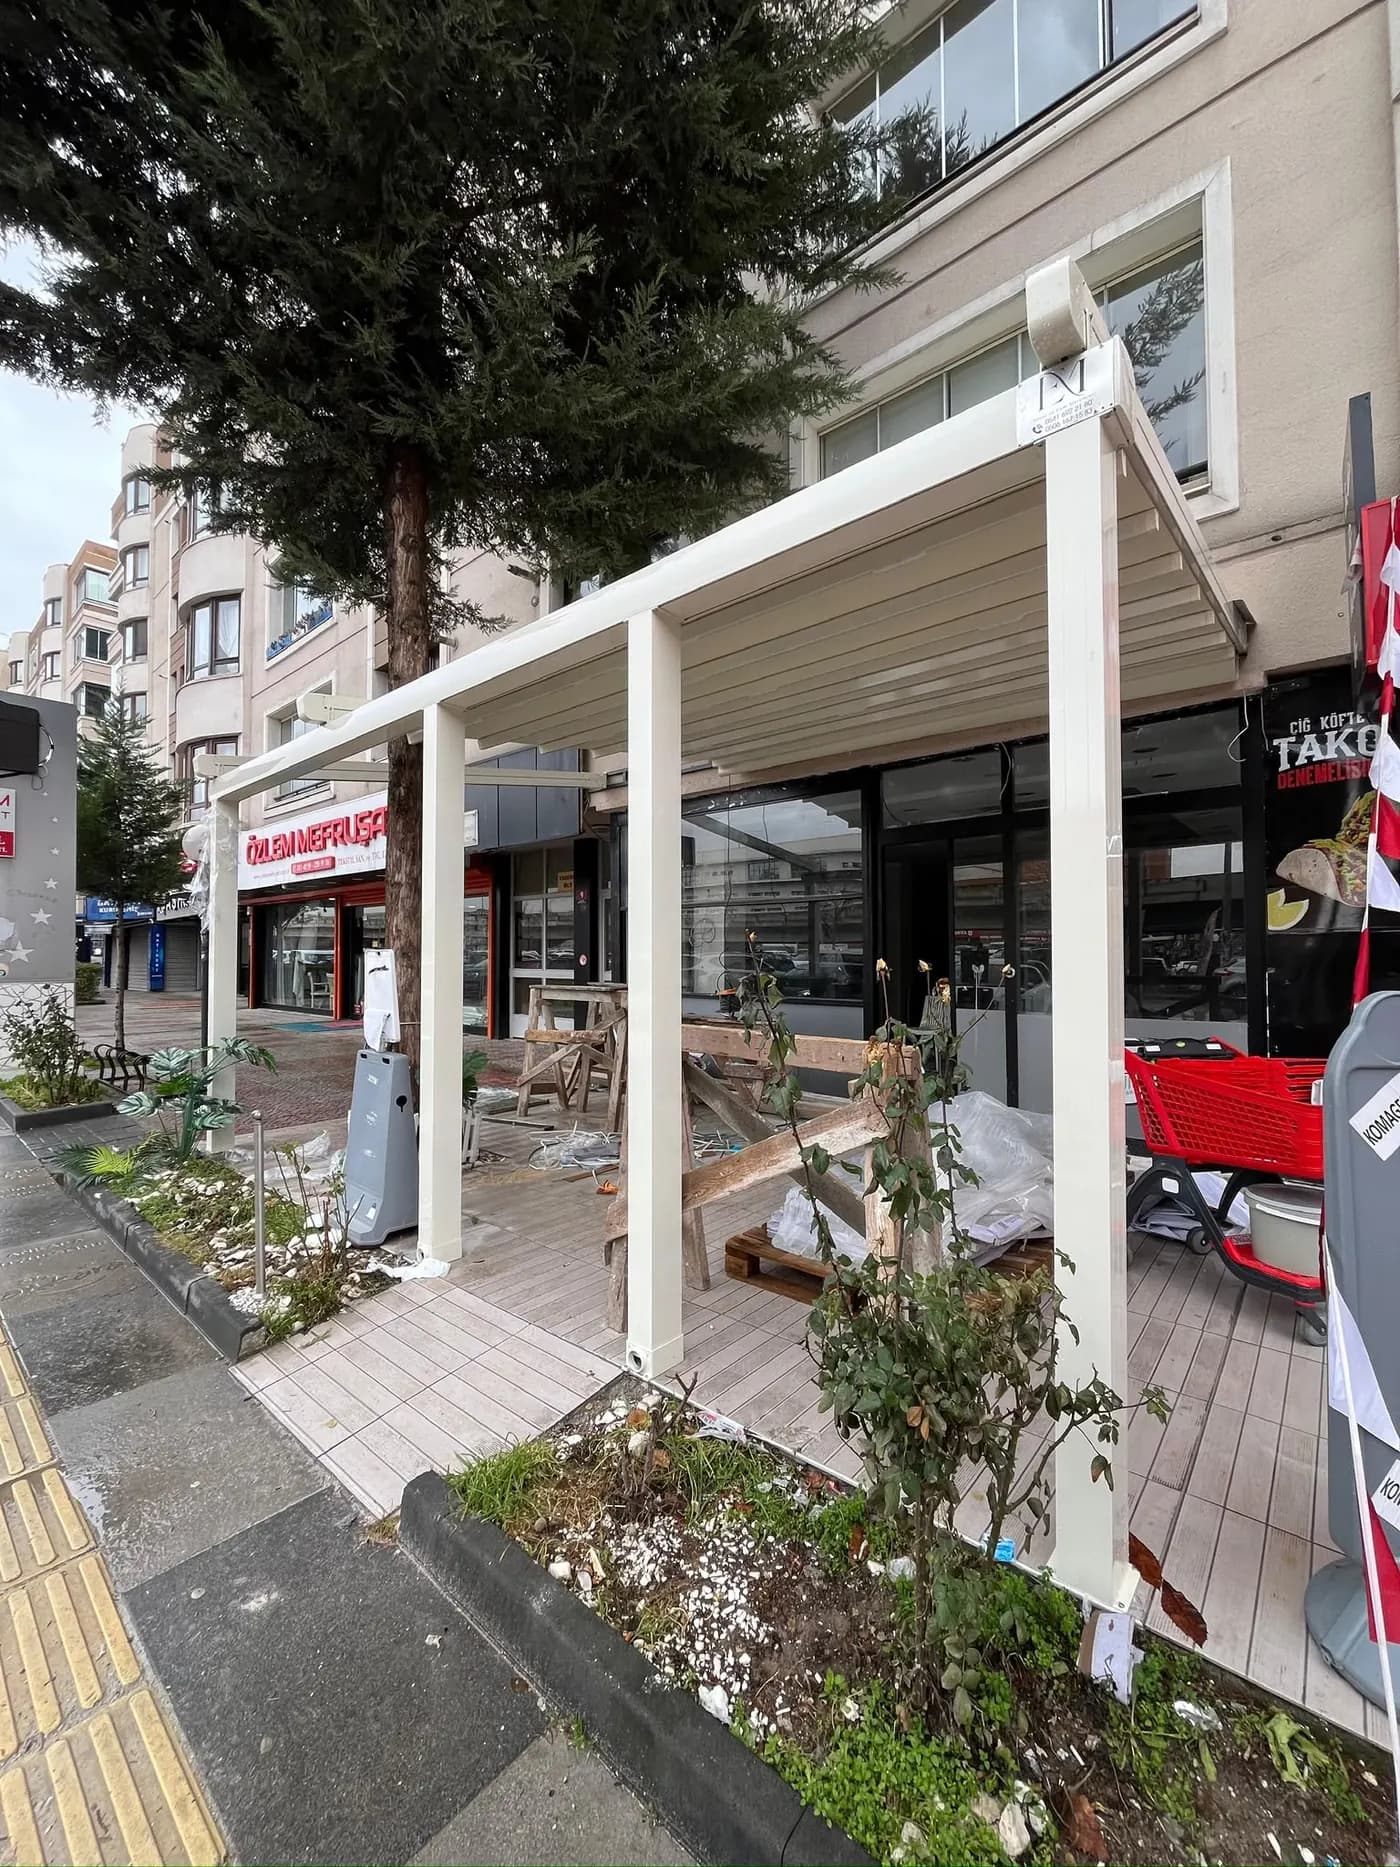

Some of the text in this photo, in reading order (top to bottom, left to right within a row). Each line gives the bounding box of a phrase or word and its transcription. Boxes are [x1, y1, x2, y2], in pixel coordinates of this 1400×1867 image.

[1290, 717, 1311, 735] ÇİĞ
[1273, 724, 1381, 772] TAKO
[1277, 759, 1371, 790] DENEMELİSİ
[247, 806, 388, 865] ÖZLEM MEFRUŞA
